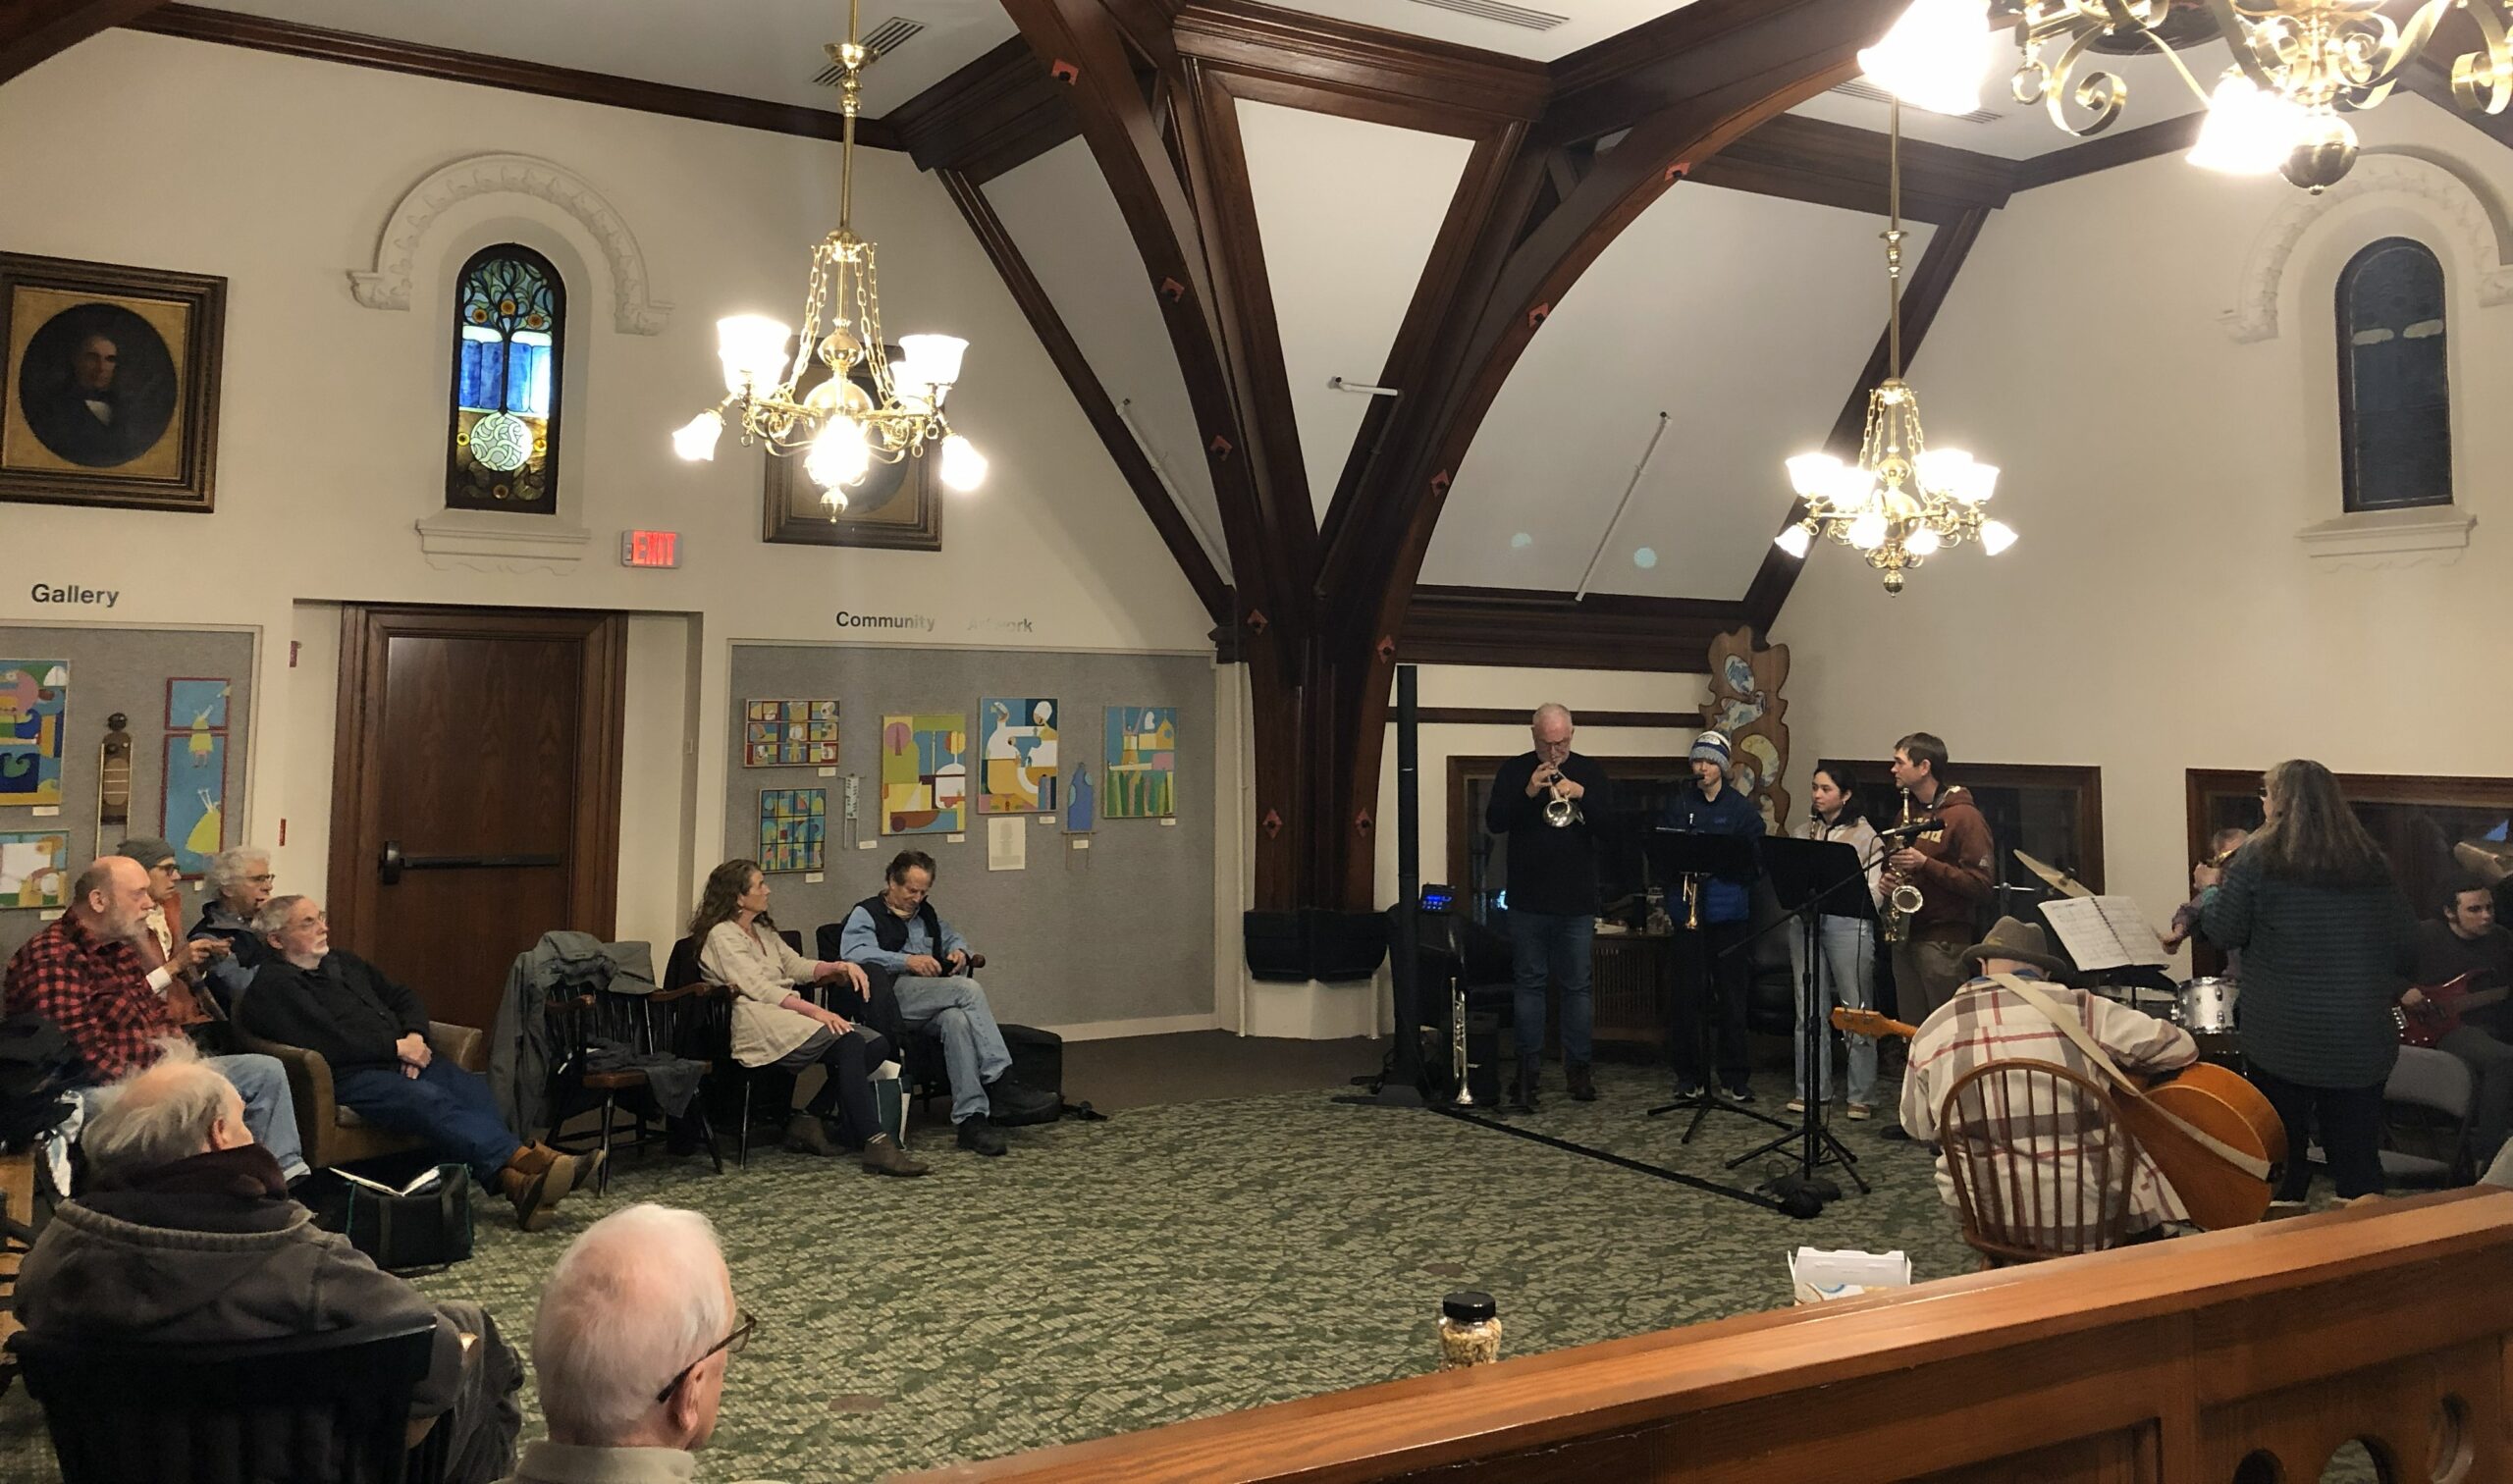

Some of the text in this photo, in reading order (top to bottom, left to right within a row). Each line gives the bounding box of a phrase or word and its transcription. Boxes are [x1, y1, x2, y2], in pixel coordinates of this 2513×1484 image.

[633, 531, 676, 566] EXIT
[31, 583, 120, 609] Gallery
[835, 610, 936, 632] Community
